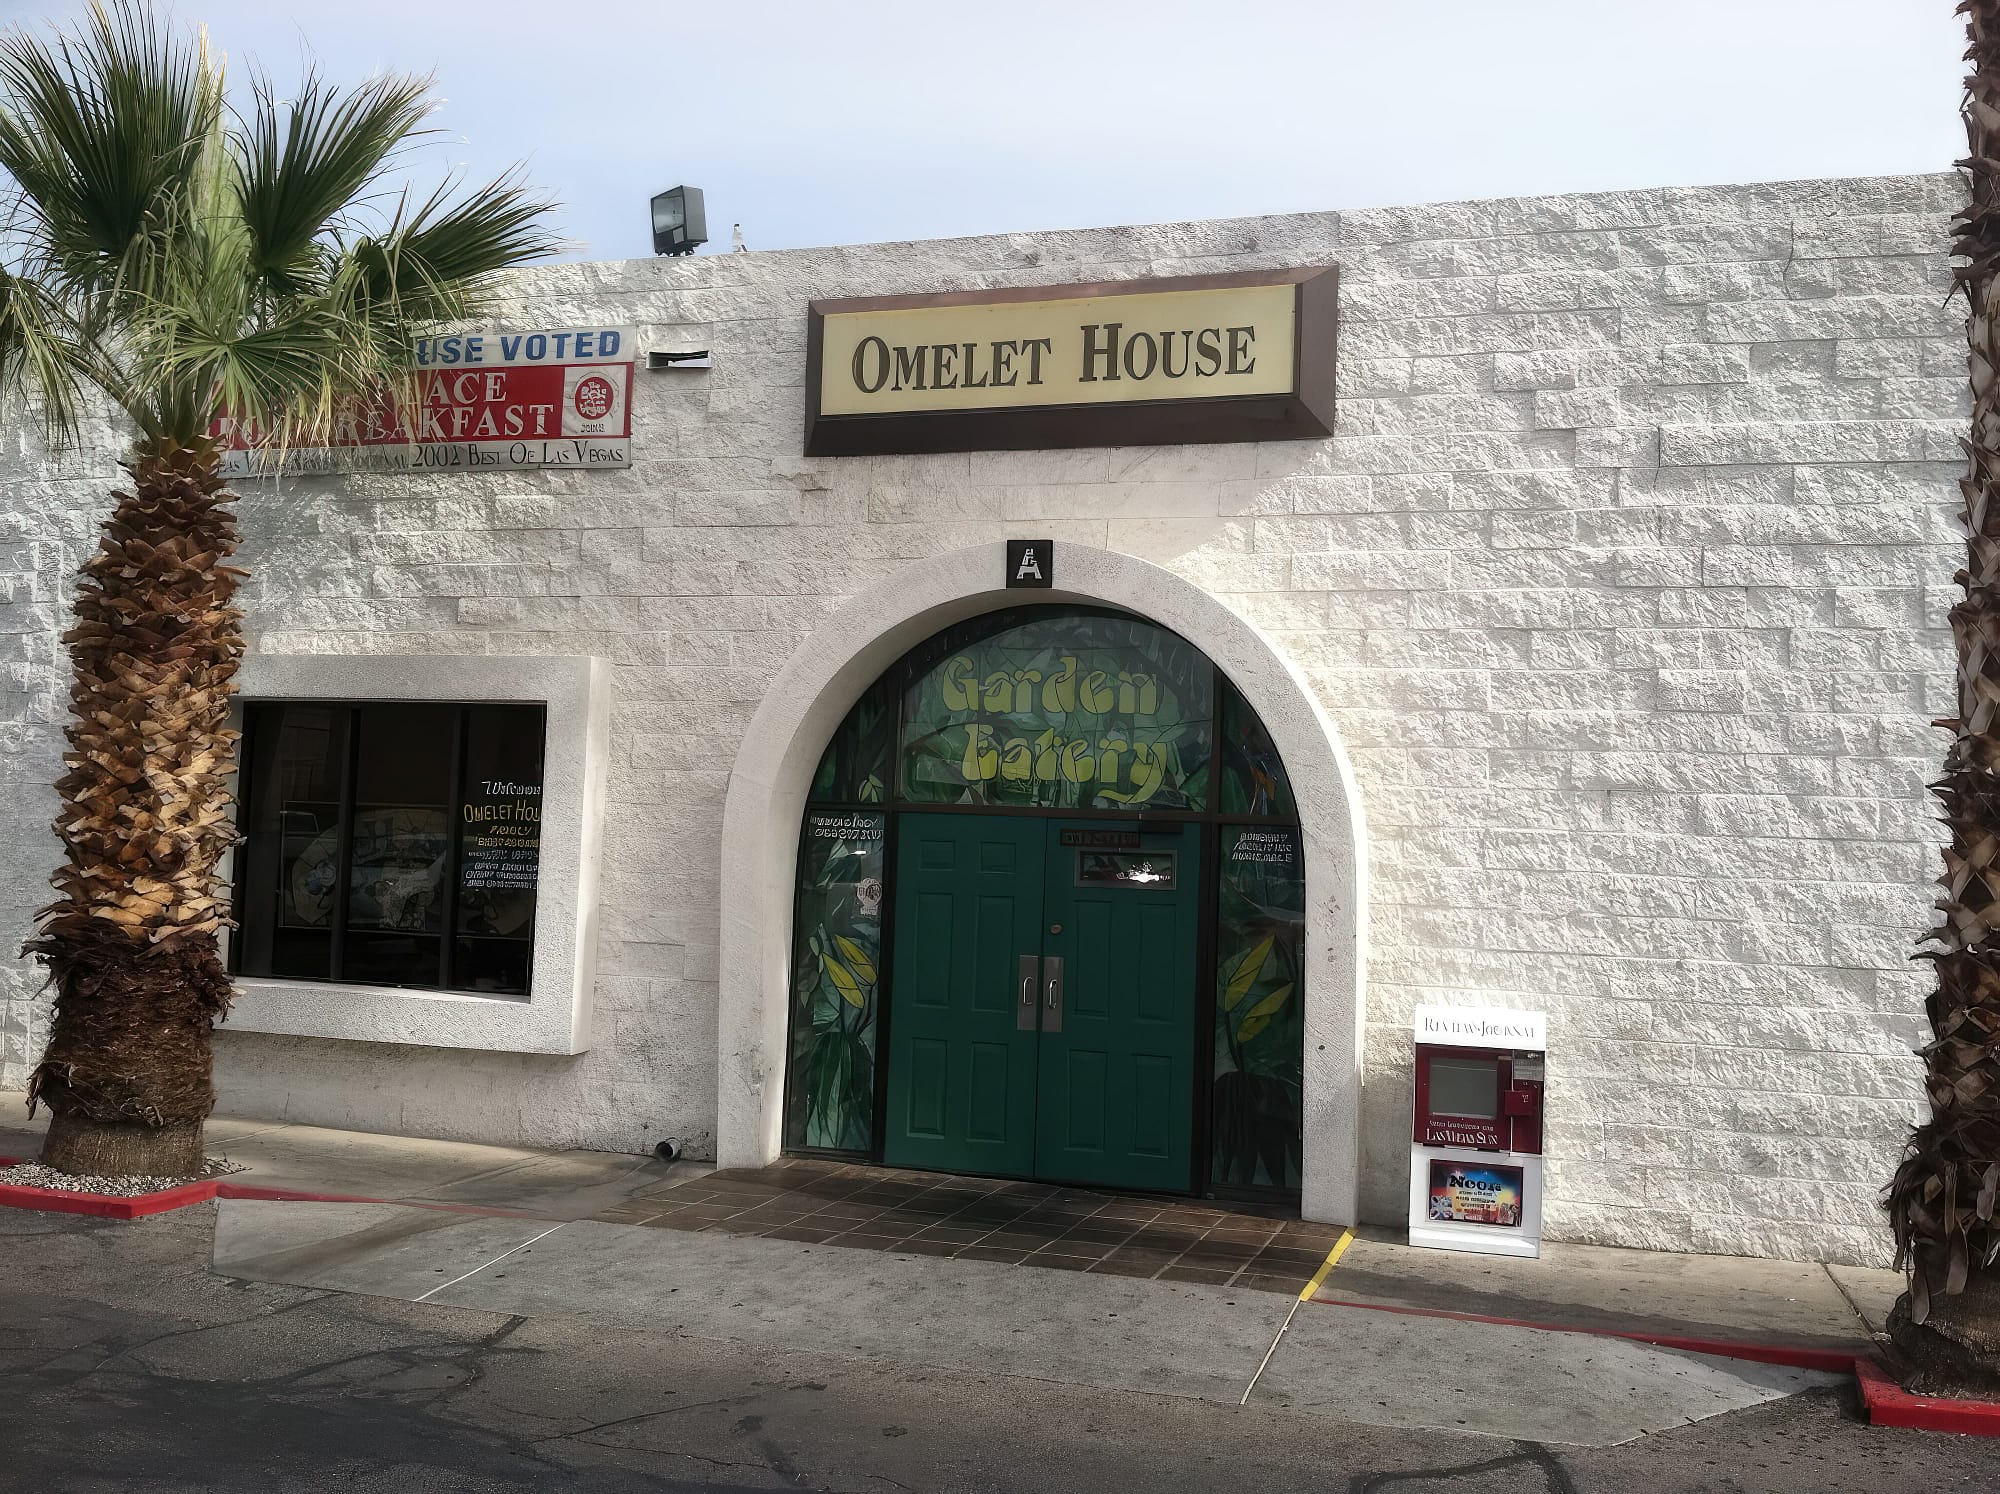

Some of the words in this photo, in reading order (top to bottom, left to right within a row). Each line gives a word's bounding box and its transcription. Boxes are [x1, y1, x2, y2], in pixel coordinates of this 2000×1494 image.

[417, 337, 484, 365] USE
[501, 331, 620, 360] VOTED
[852, 336, 1051, 394] OMELET
[1079, 323, 1256, 382] HOUSE
[424, 372, 507, 405] ACE
[943, 656, 1158, 715] Garden
